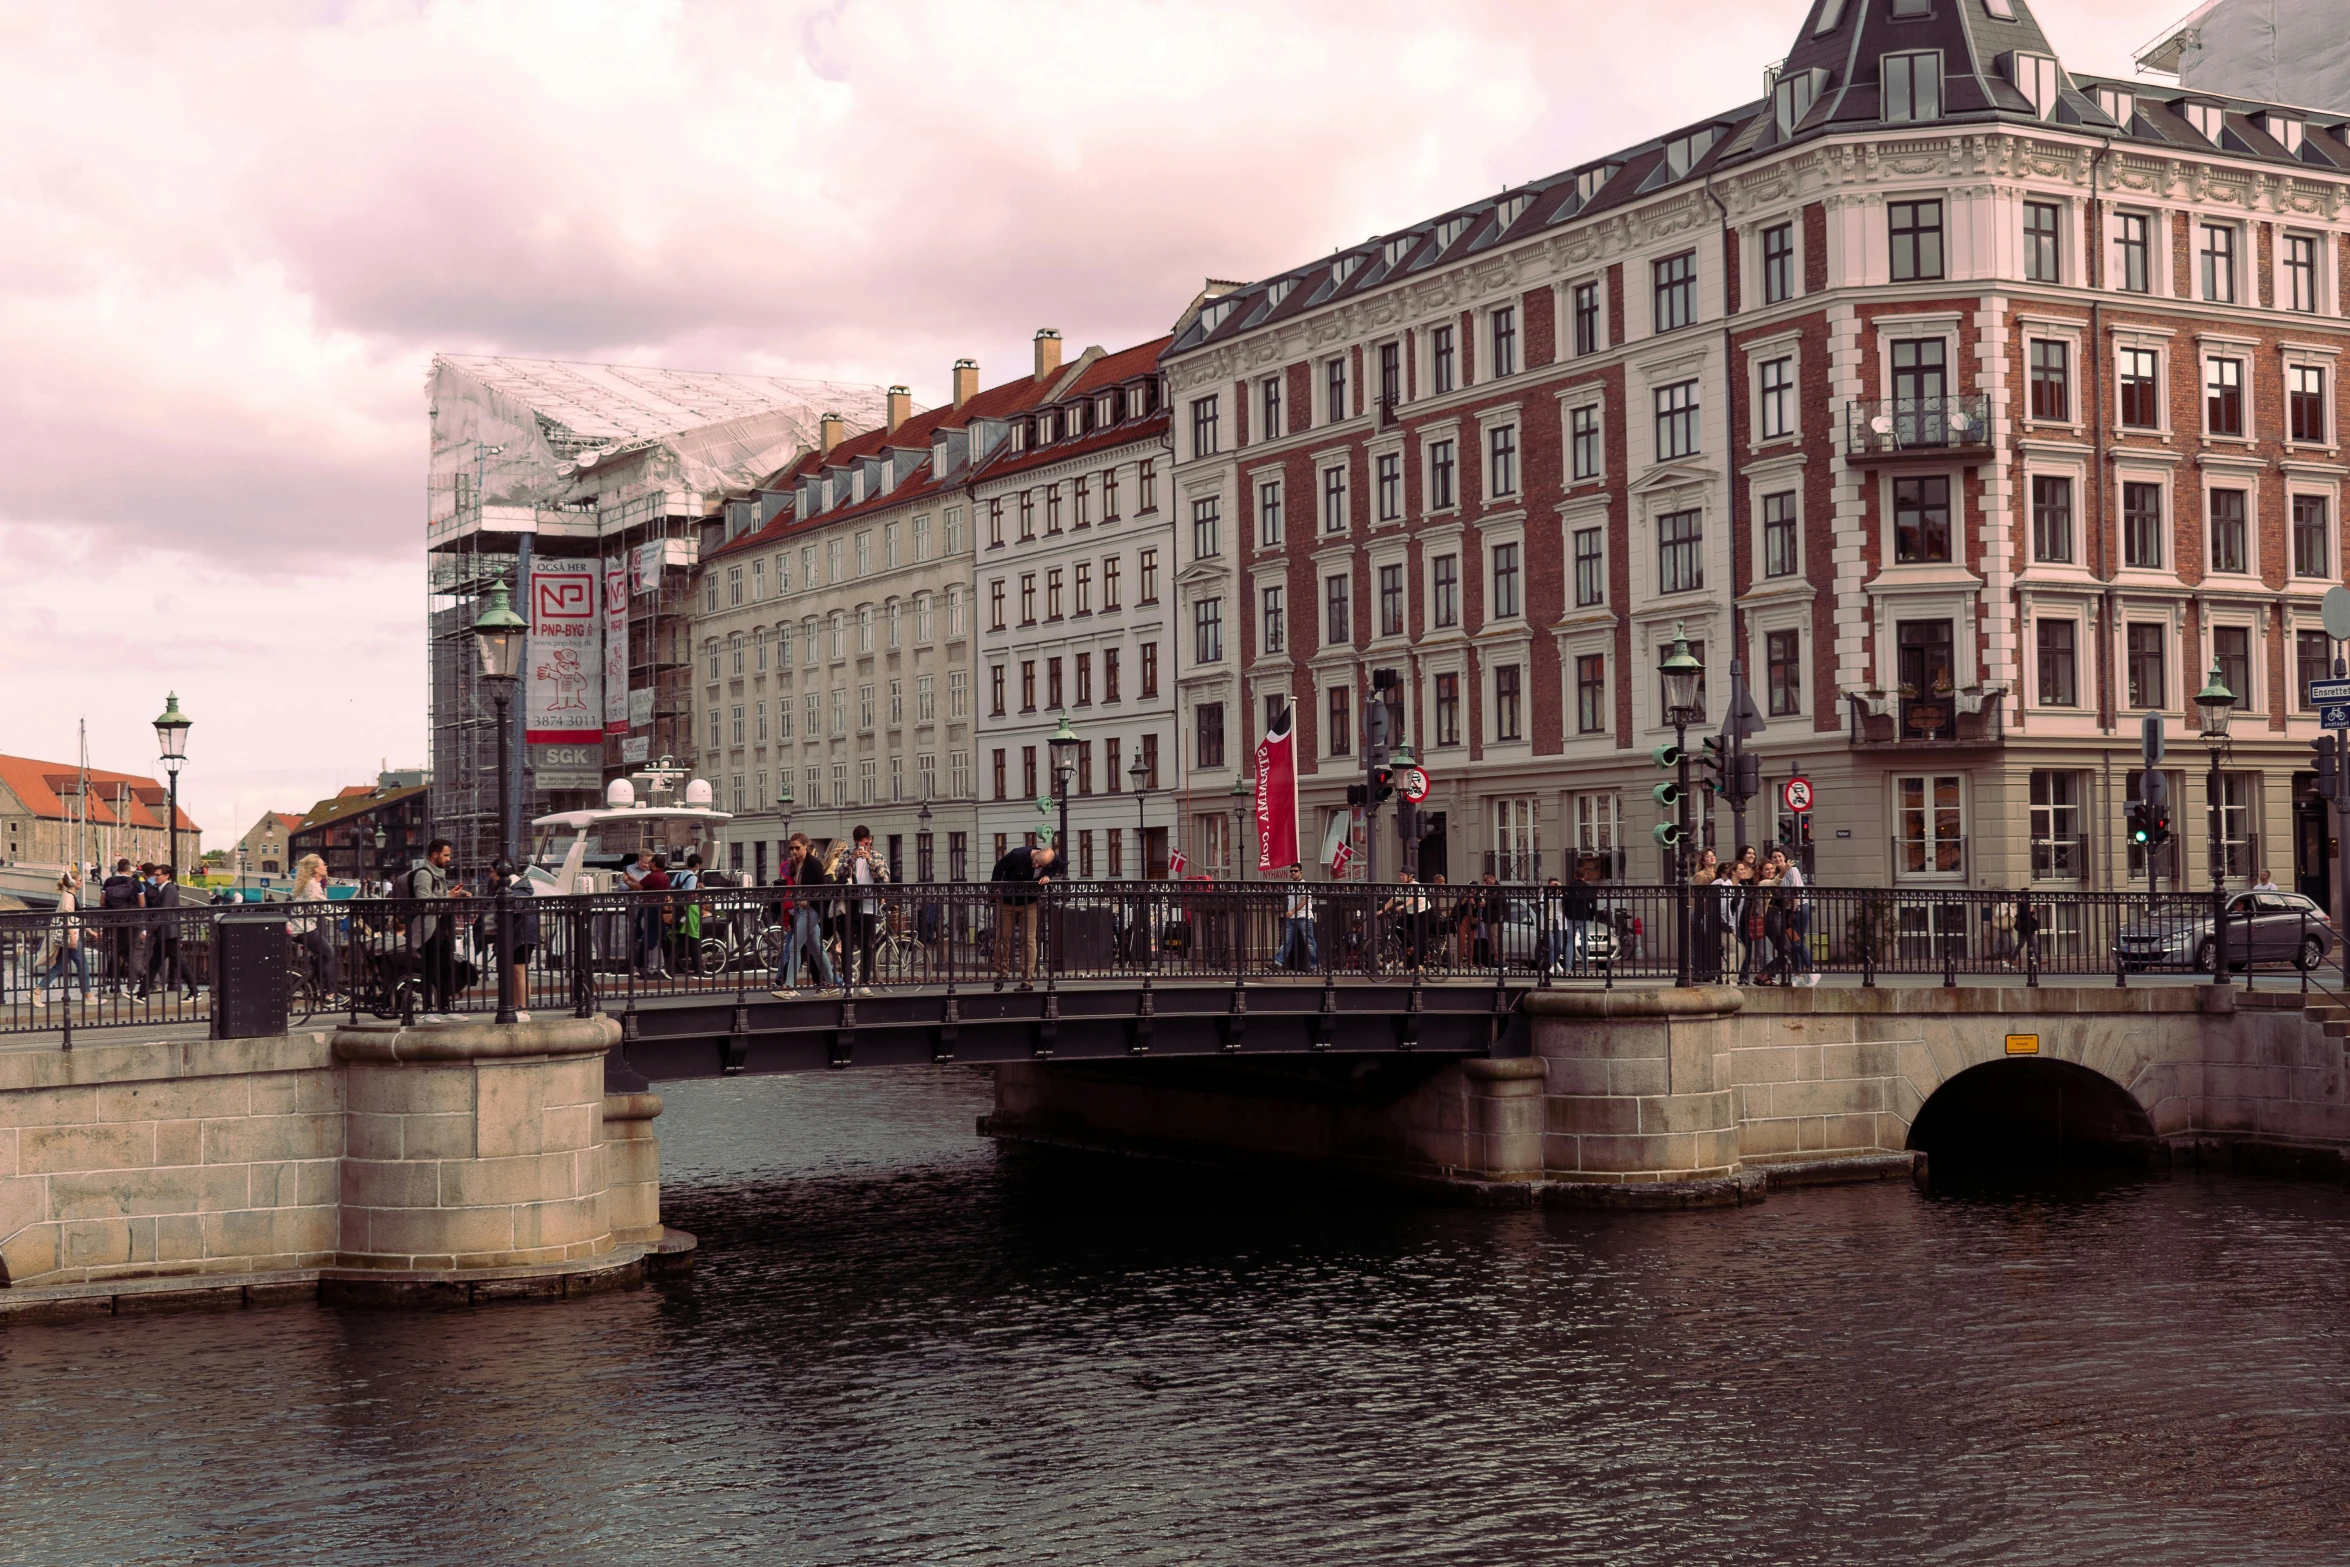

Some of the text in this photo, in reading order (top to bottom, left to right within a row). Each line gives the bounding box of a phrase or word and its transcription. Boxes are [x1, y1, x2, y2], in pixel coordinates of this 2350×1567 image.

[537, 562, 587, 572] OGSÅ HER
[541, 623, 585, 637] PNP-BYG
[534, 639, 593, 649] www.pnp-byg.dk
[534, 715, 564, 727] 3874
[567, 715, 597, 727] 3011
[546, 748, 589, 765] SGK
[1262, 870, 1289, 880] NYHAVN
